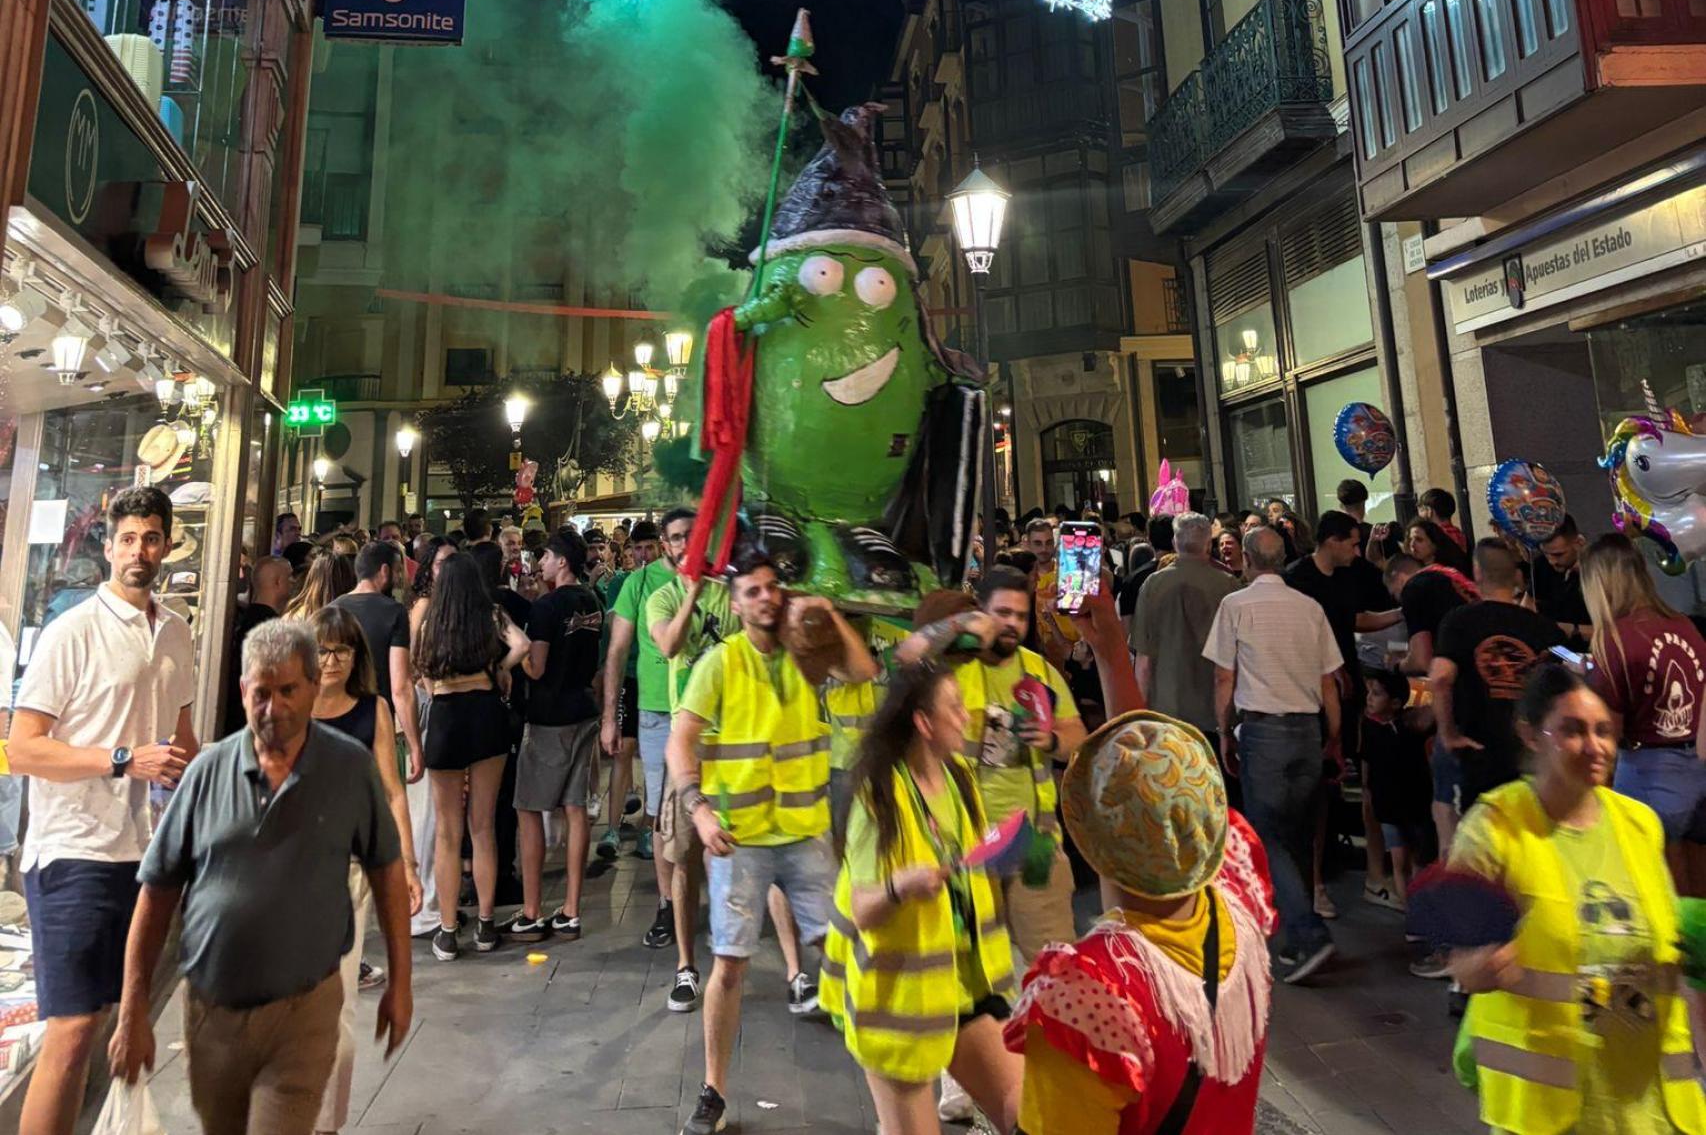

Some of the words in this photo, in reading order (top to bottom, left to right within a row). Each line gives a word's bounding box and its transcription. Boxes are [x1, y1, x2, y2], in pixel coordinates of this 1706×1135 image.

[331, 9, 454, 31] Samsonite
[1464, 278, 1498, 304] Loterías
[1525, 253, 1570, 285] Apuestas
[1573, 240, 1590, 265] del
[1592, 226, 1632, 259] Estado
